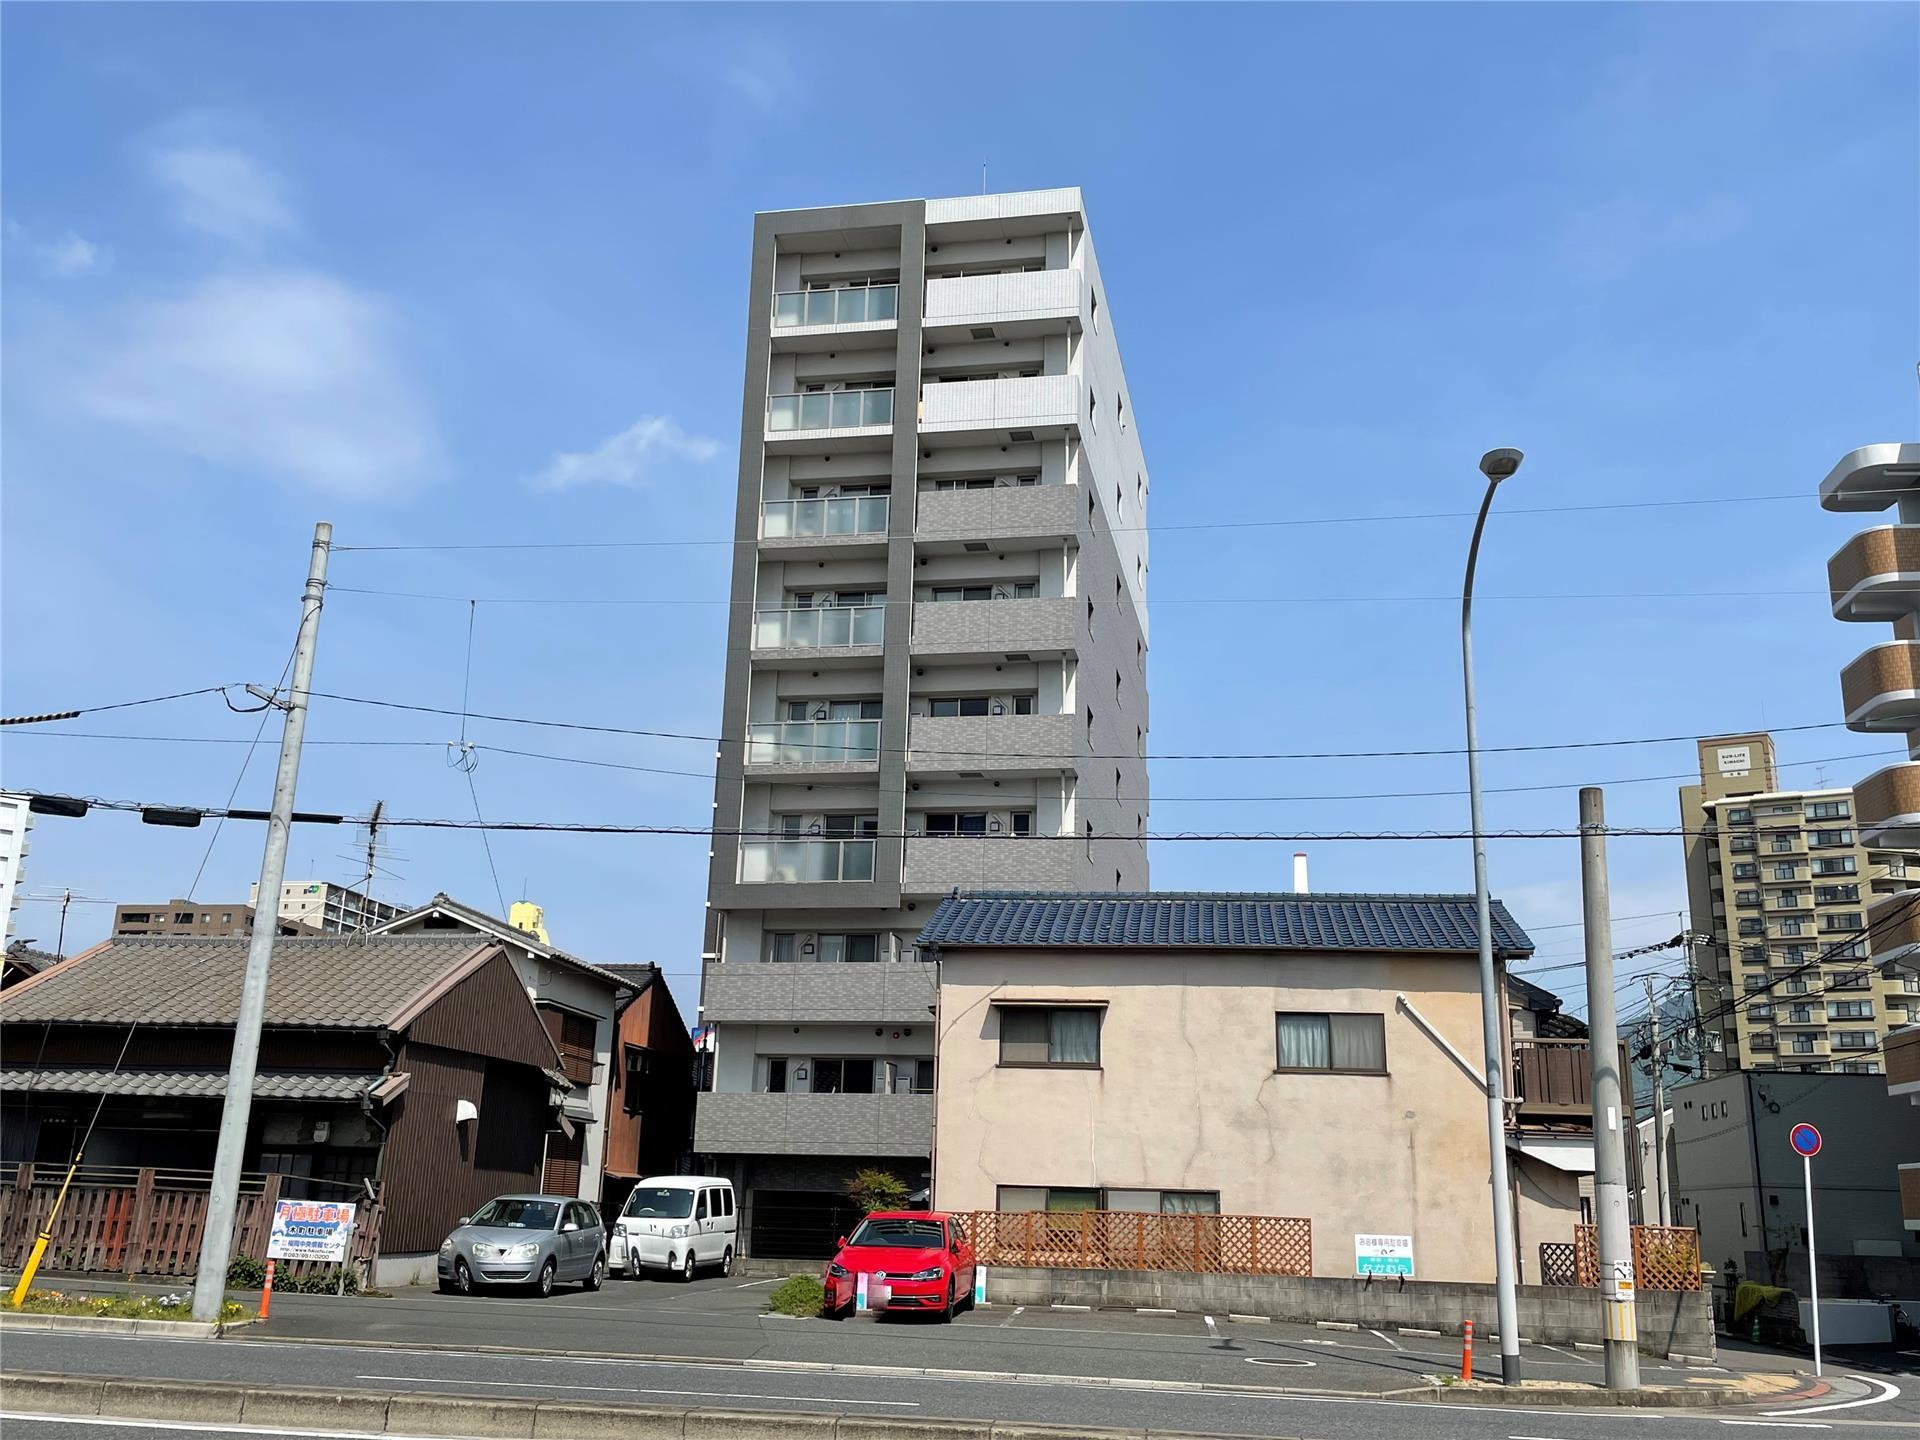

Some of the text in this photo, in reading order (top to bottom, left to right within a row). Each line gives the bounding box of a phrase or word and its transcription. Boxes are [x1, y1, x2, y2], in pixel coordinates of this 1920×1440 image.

[280, 1206, 350, 1224] 月極駐車場
[289, 1226, 333, 1236] 木町駐車場
